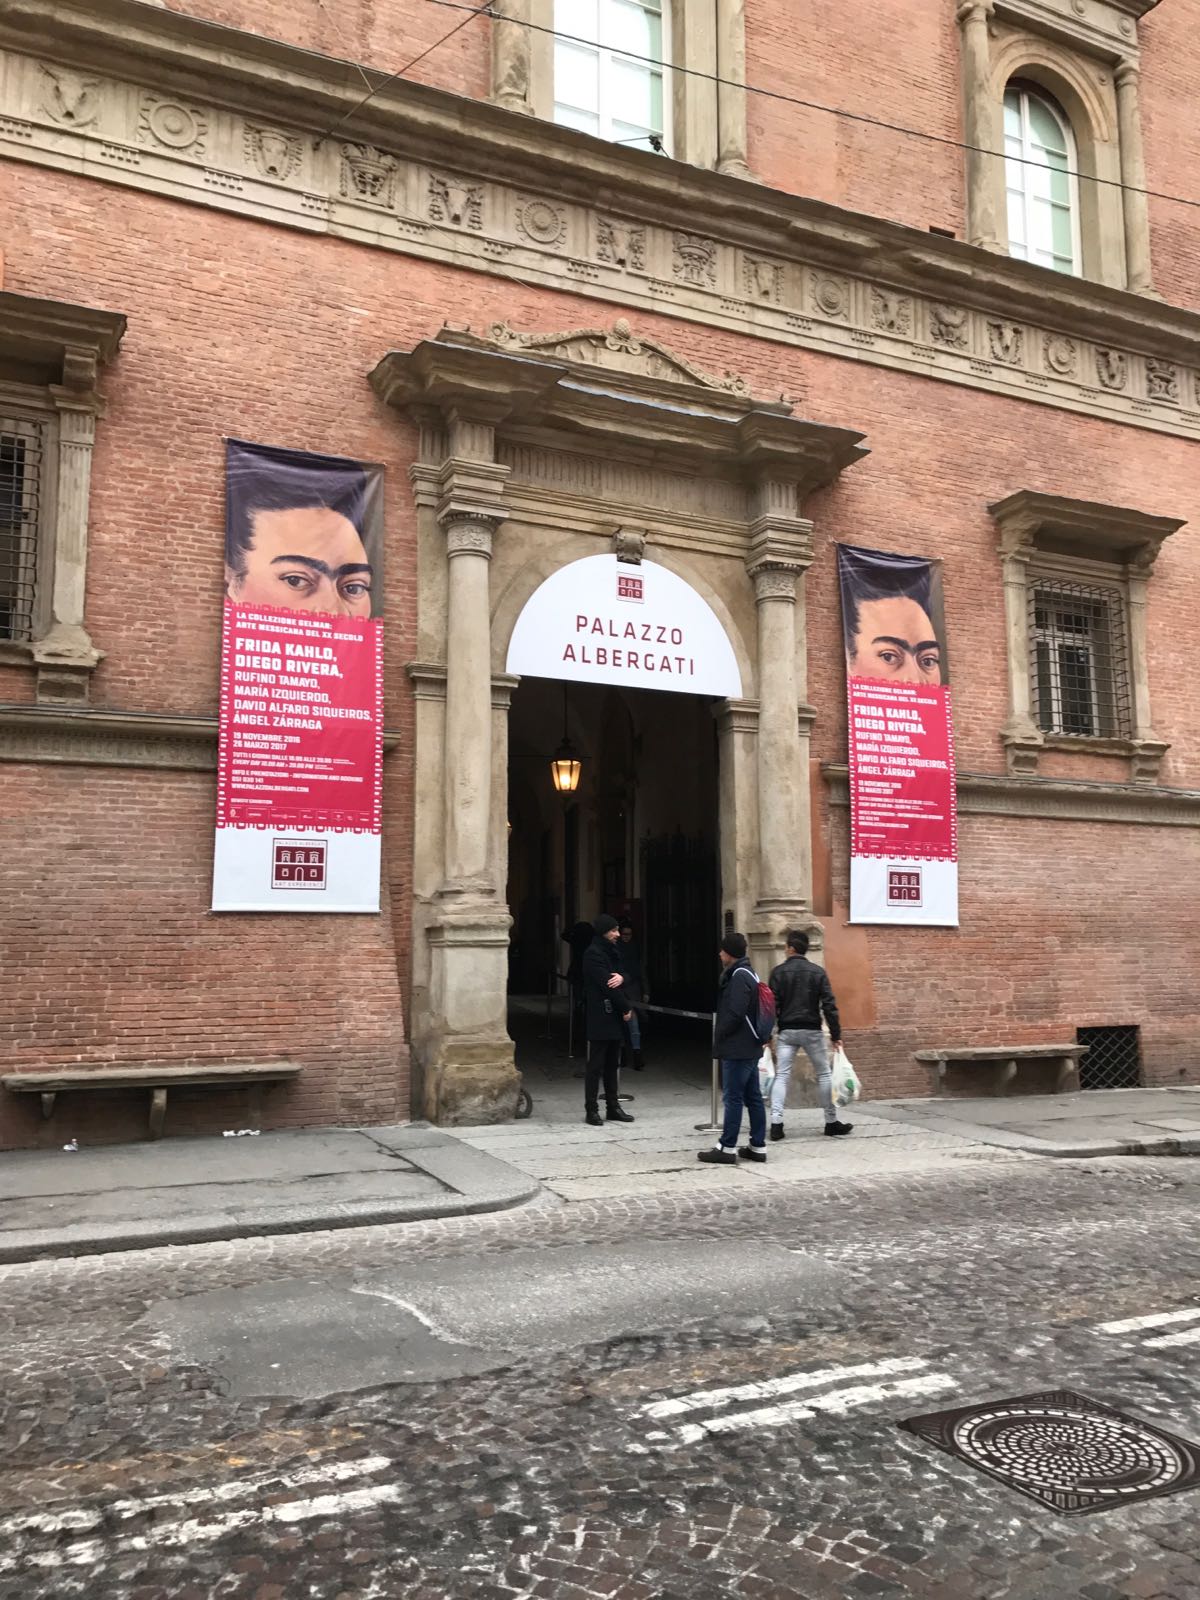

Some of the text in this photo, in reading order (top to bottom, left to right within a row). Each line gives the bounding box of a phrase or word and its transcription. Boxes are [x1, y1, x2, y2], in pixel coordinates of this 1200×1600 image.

[248, 613, 296, 626] COLLEZIONE
[236, 622, 363, 642] ARTE MESSICANA DEL XX SECOLO
[576, 615, 683, 645] PALAZZO
[236, 638, 337, 662] FRIDA KAHLO,
[235, 654, 343, 678] DIEGO RIVERA,
[563, 644, 694, 675] ALBERGATI
[234, 672, 320, 690] RUFINO TAMAYO,
[234, 684, 331, 704] MARÍA IZQUIERDO,
[234, 700, 373, 722] DAVID ALFARO SIQUEIROS,
[854, 705, 922, 722] FRIDA KAHLO,
[233, 711, 322, 730] ÁNGEL ZÁRRAGA
[854, 718, 926, 735] DIEGO RIVERA,
[233, 740, 242, 748] 26
[244, 741, 269, 750] MARZO
[243, 732, 283, 742] NOVEMBRE
[284, 736, 300, 744] 2016
[856, 731, 912, 744] RUFINO TAMAYO,
[856, 742, 879, 752] MARÍA
[857, 754, 879, 763] DAVID
[880, 756, 907, 766] ALFARO
